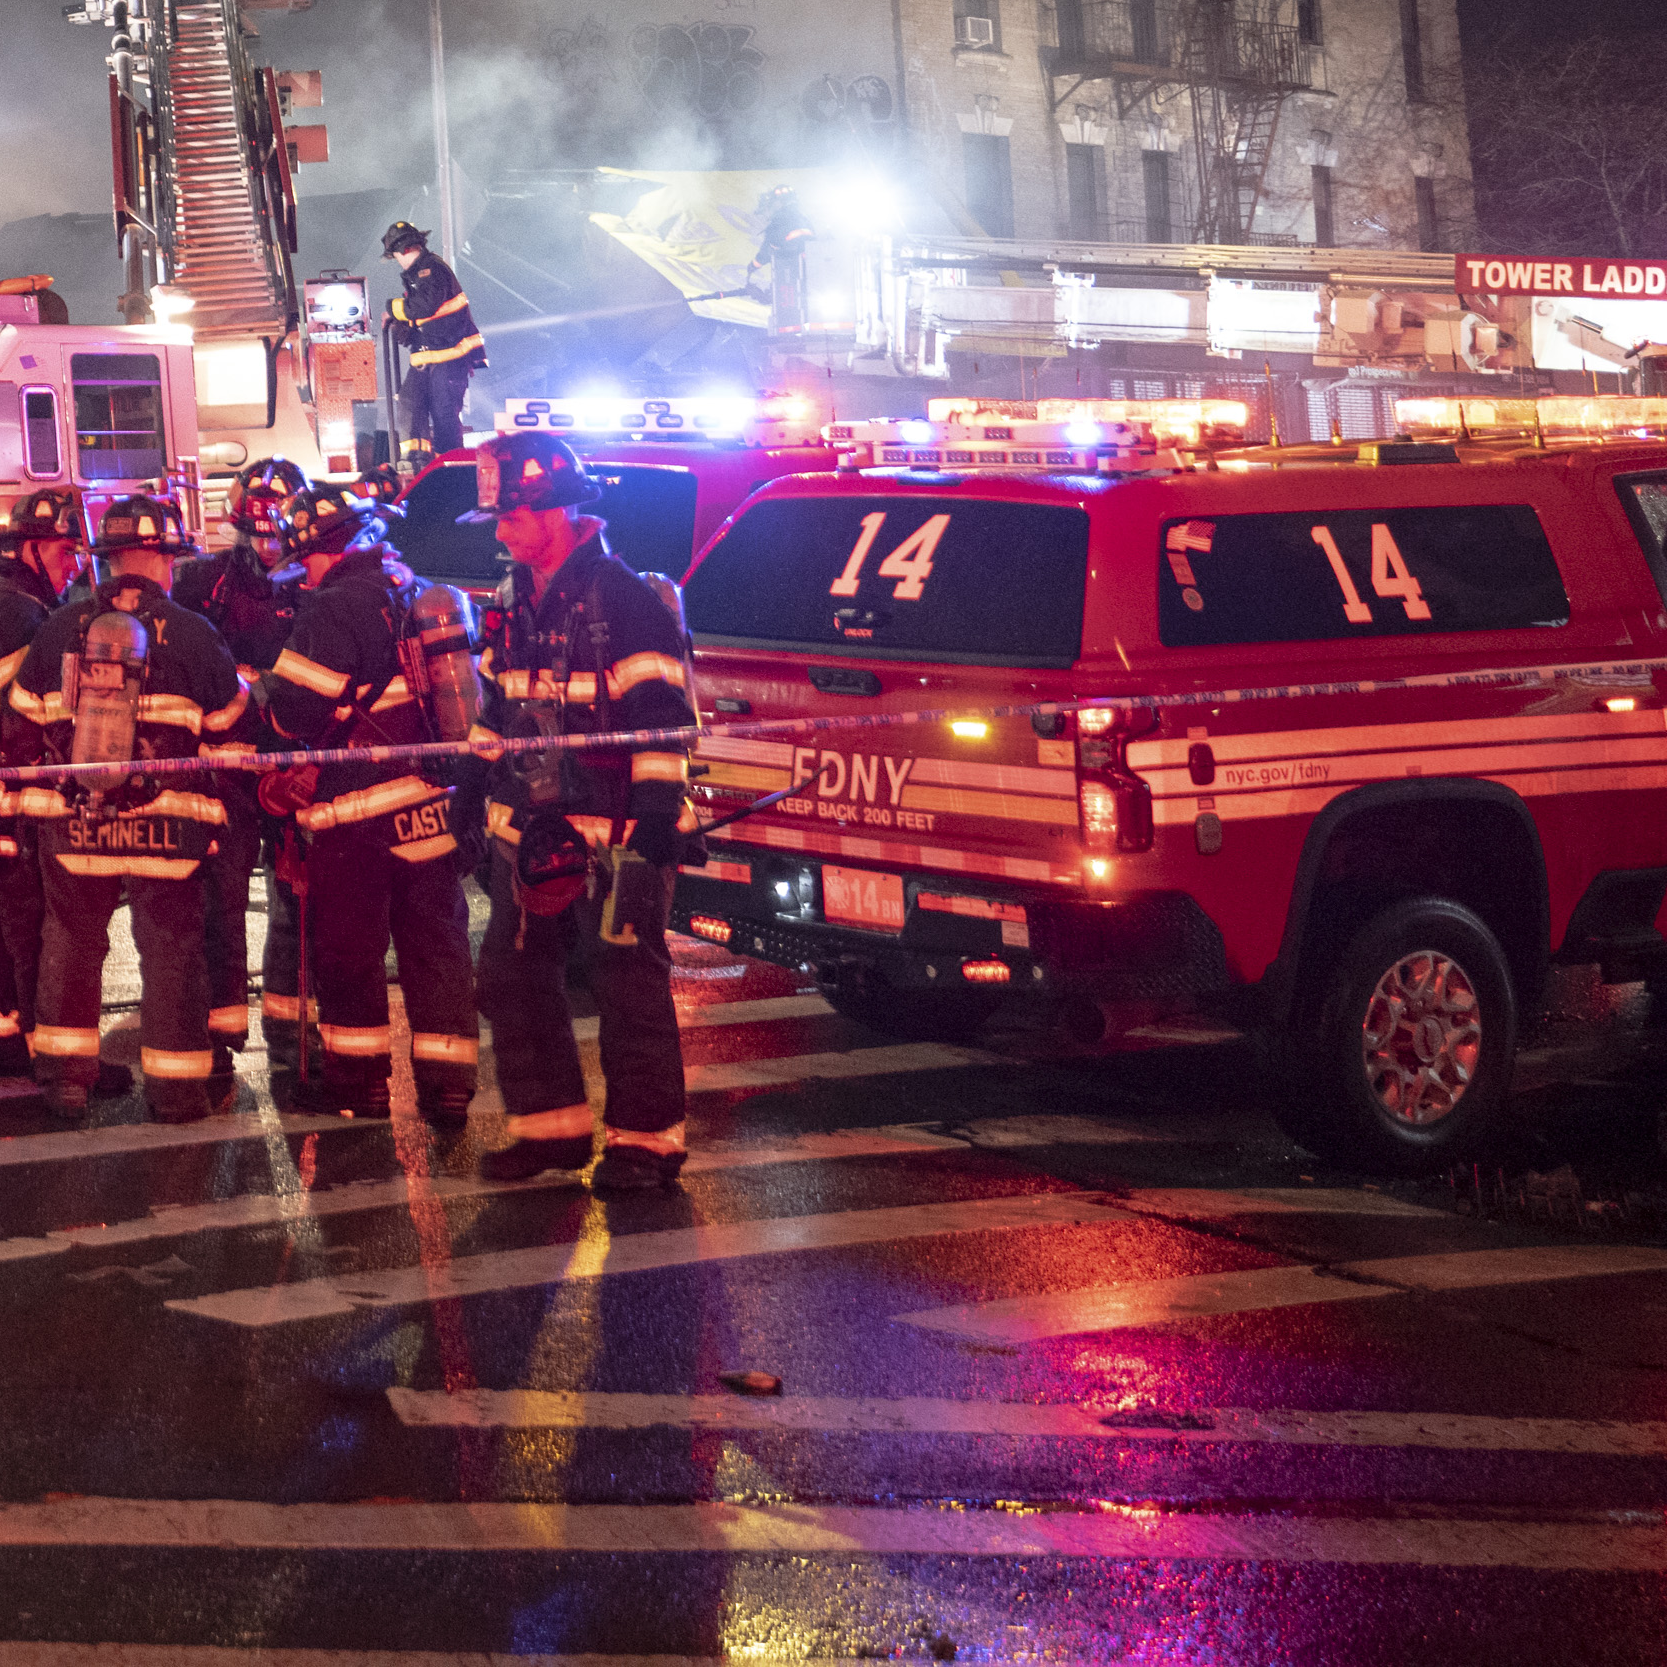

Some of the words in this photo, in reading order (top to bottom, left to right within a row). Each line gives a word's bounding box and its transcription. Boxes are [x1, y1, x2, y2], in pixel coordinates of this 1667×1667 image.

[1467, 260, 1573, 292] TOWER
[830, 511, 952, 601] 14
[1310, 523, 1432, 624] 14
[793, 746, 913, 806] FDNY
[1226, 763, 1331, 786] nyc.gov/fdny
[776, 797, 813, 816] KEEP
[818, 800, 858, 822] BACK
[863, 806, 891, 827] 200
[896, 810, 935, 832] FEET
[850, 878, 878, 917] 14
[882, 900, 902, 919] BN
